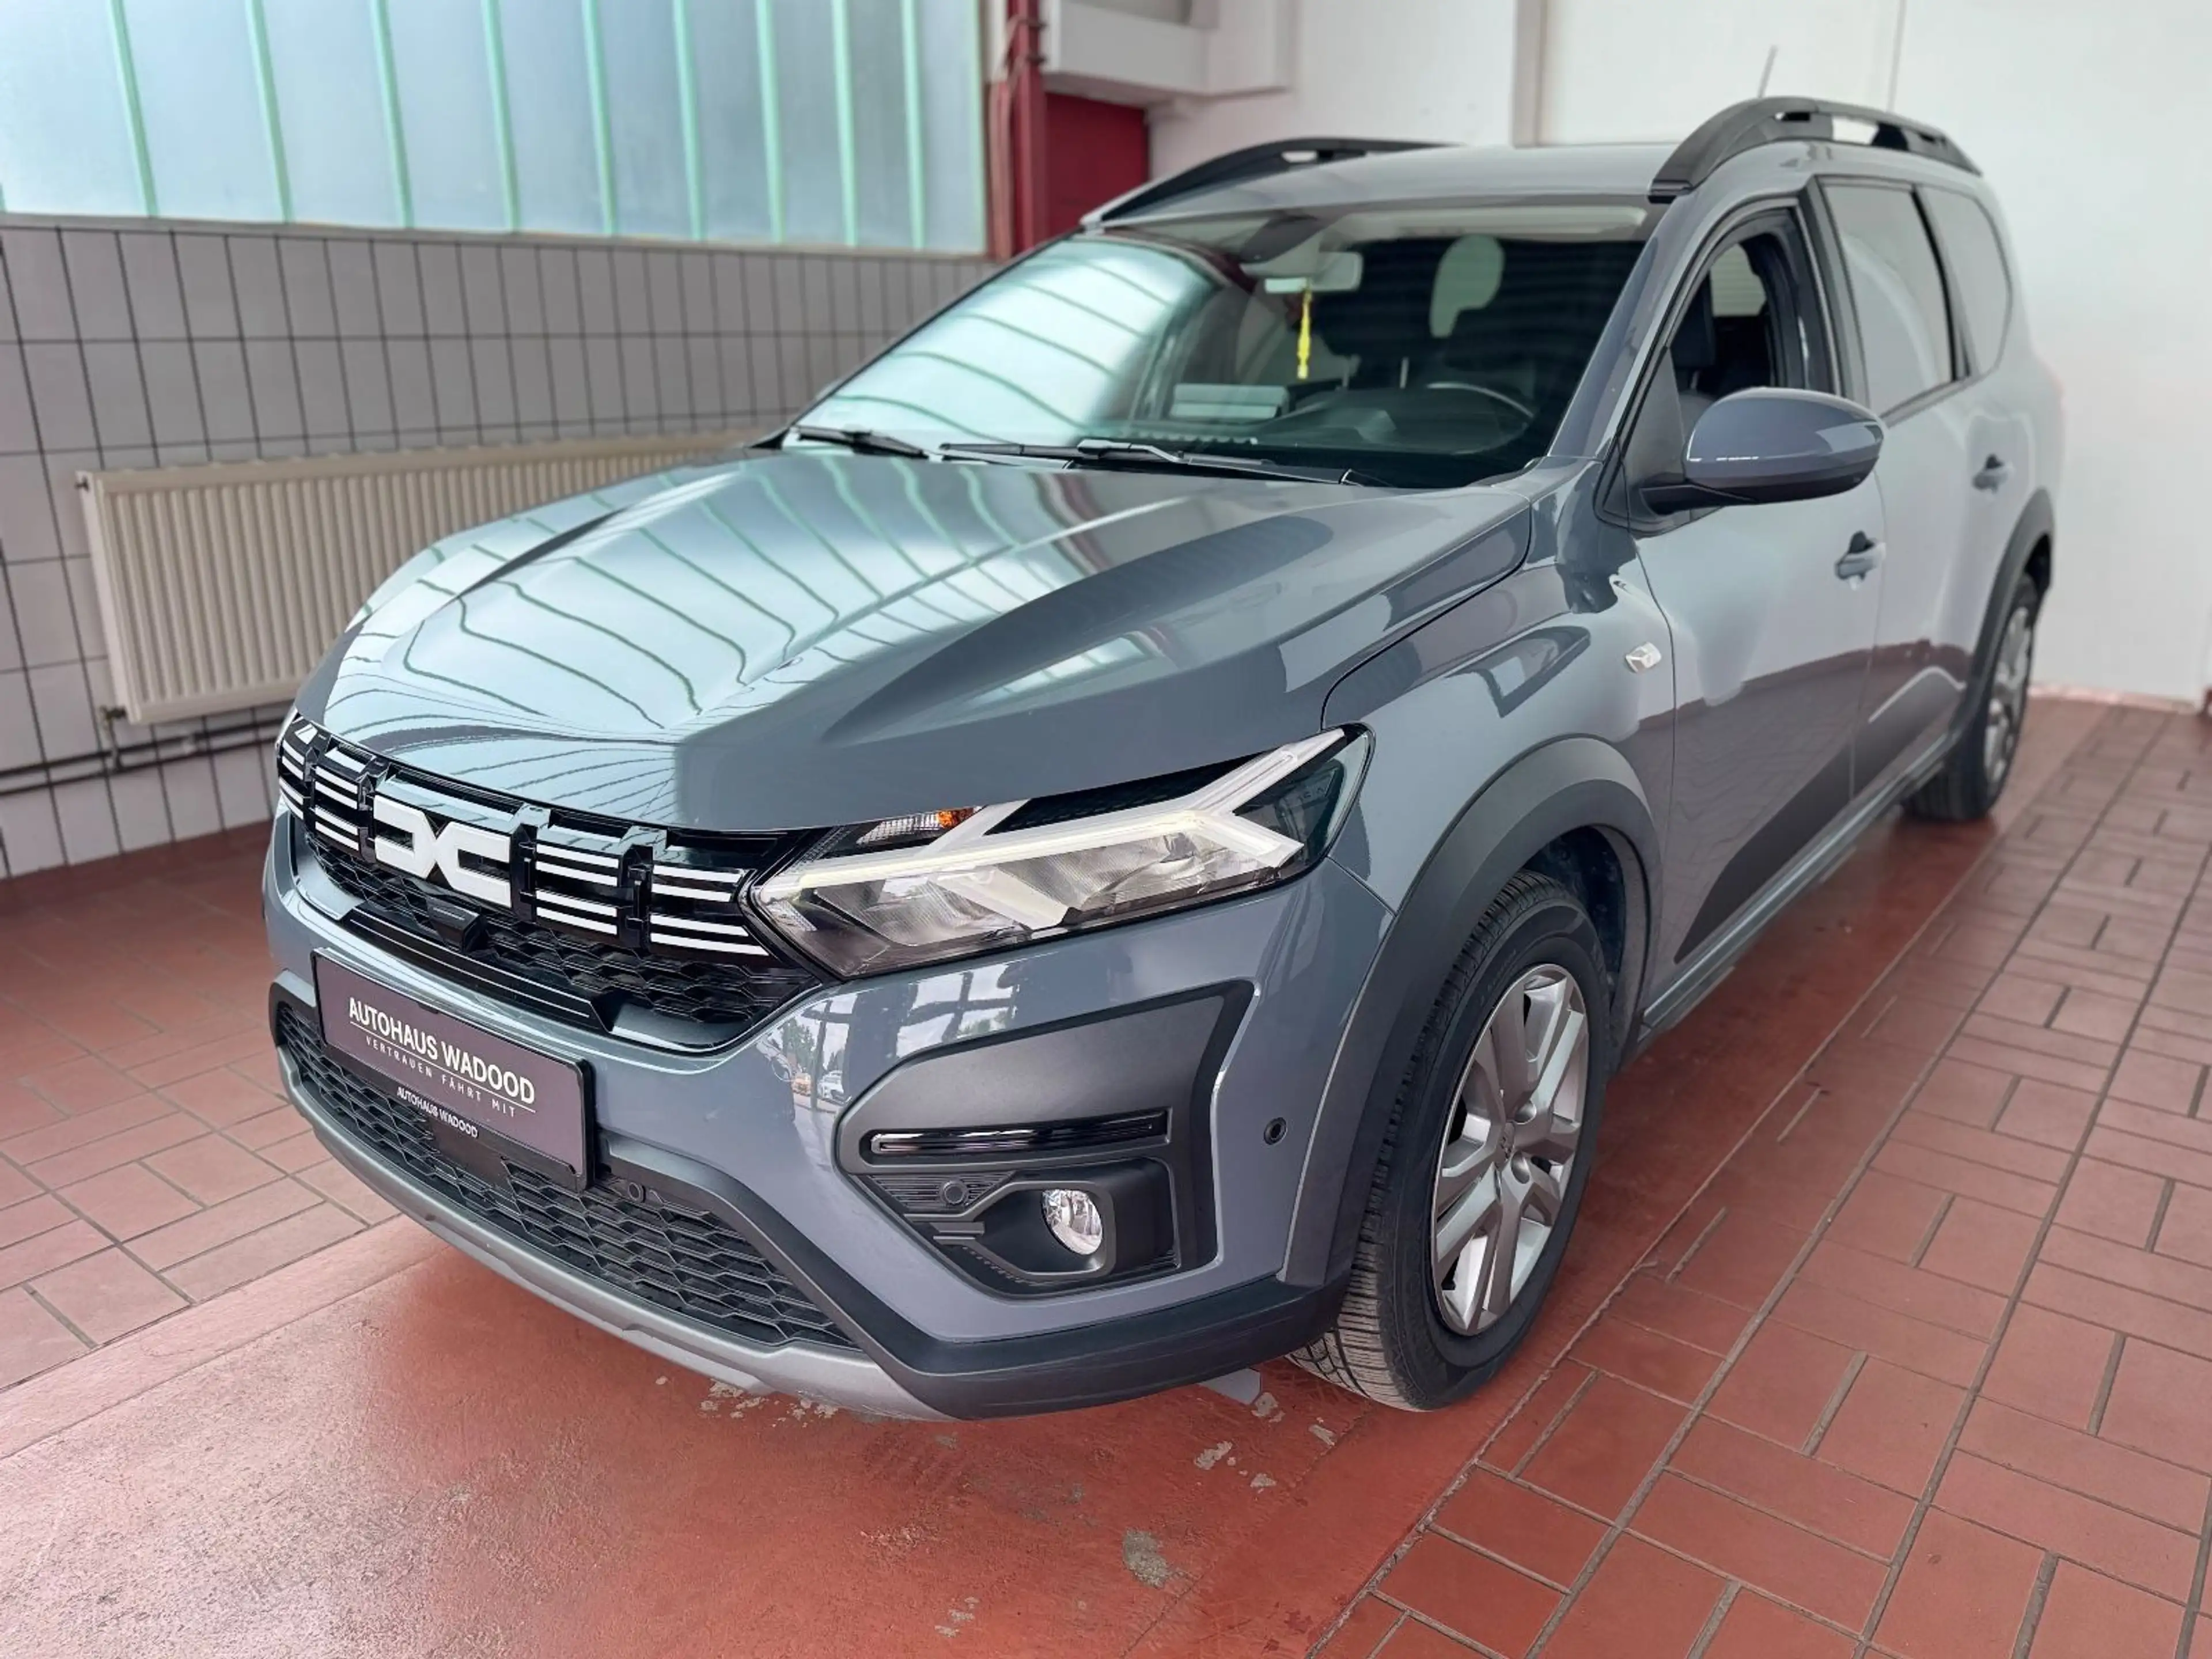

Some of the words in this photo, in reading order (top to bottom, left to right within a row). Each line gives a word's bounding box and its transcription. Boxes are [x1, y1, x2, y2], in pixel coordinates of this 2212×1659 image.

[349, 997, 438, 1060] AUTOHAUS
[441, 1041, 535, 1104] WADOOD
[366, 1036, 433, 1078] VERTRAUEN
[491, 1100, 516, 1118] MIT
[396, 1086, 439, 1116] AUTOHAUS
[440, 1109, 478, 1138] WADOOD
